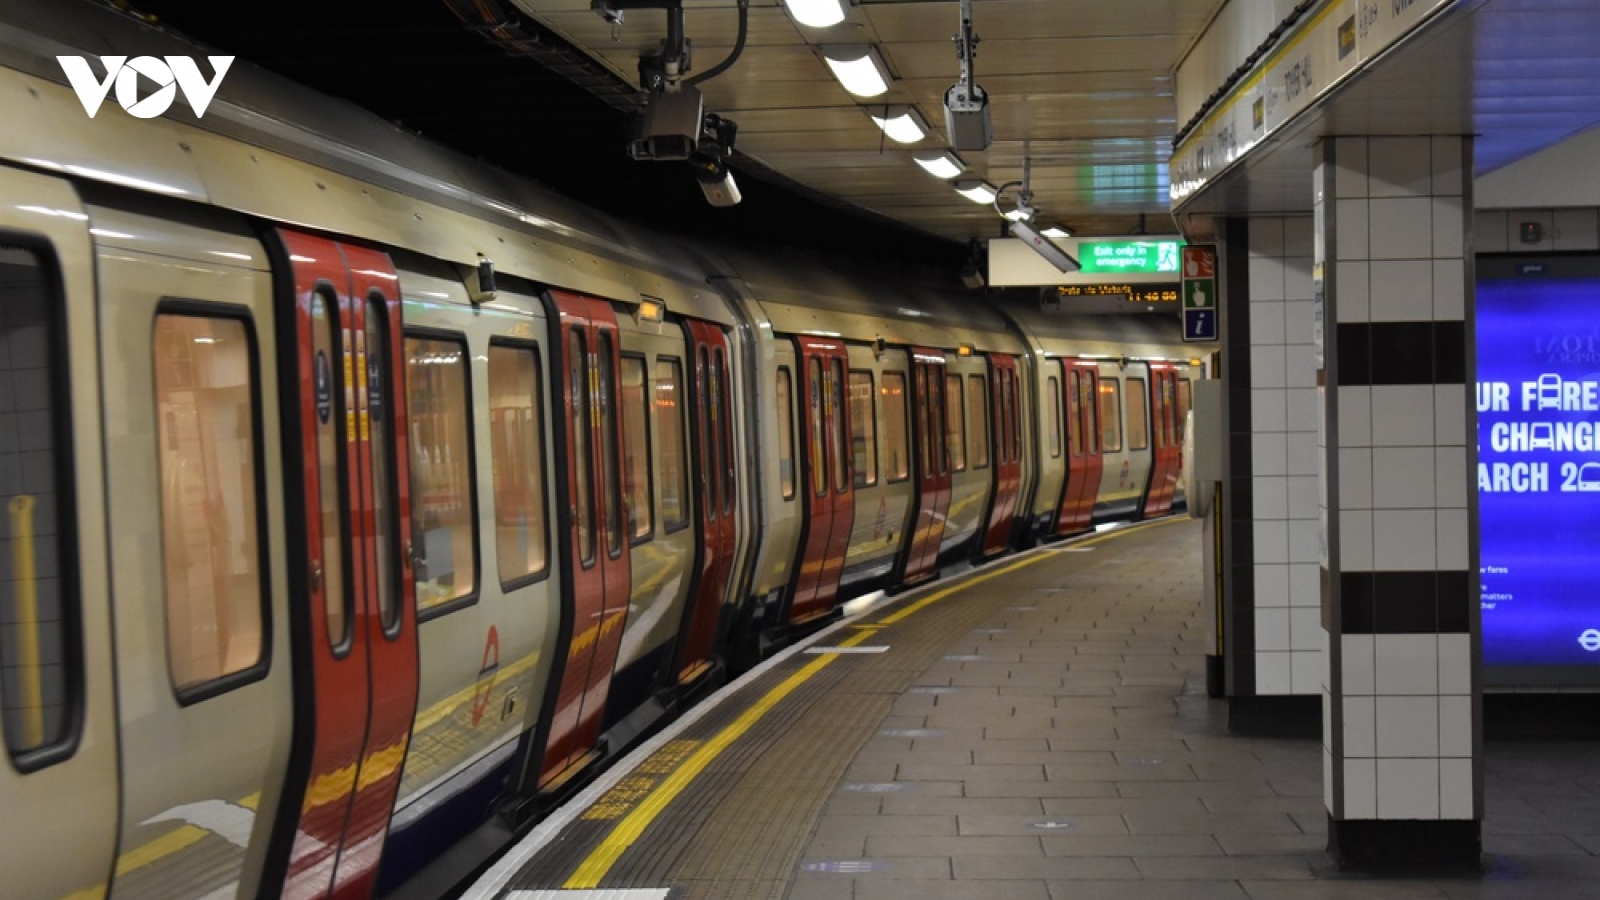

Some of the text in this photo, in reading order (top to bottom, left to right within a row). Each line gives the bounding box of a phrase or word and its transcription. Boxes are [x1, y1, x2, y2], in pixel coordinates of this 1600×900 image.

[1094, 245, 1147, 257] Exit only in
[1096, 258, 1147, 268] emergency
[1487, 565, 1509, 574] fares
